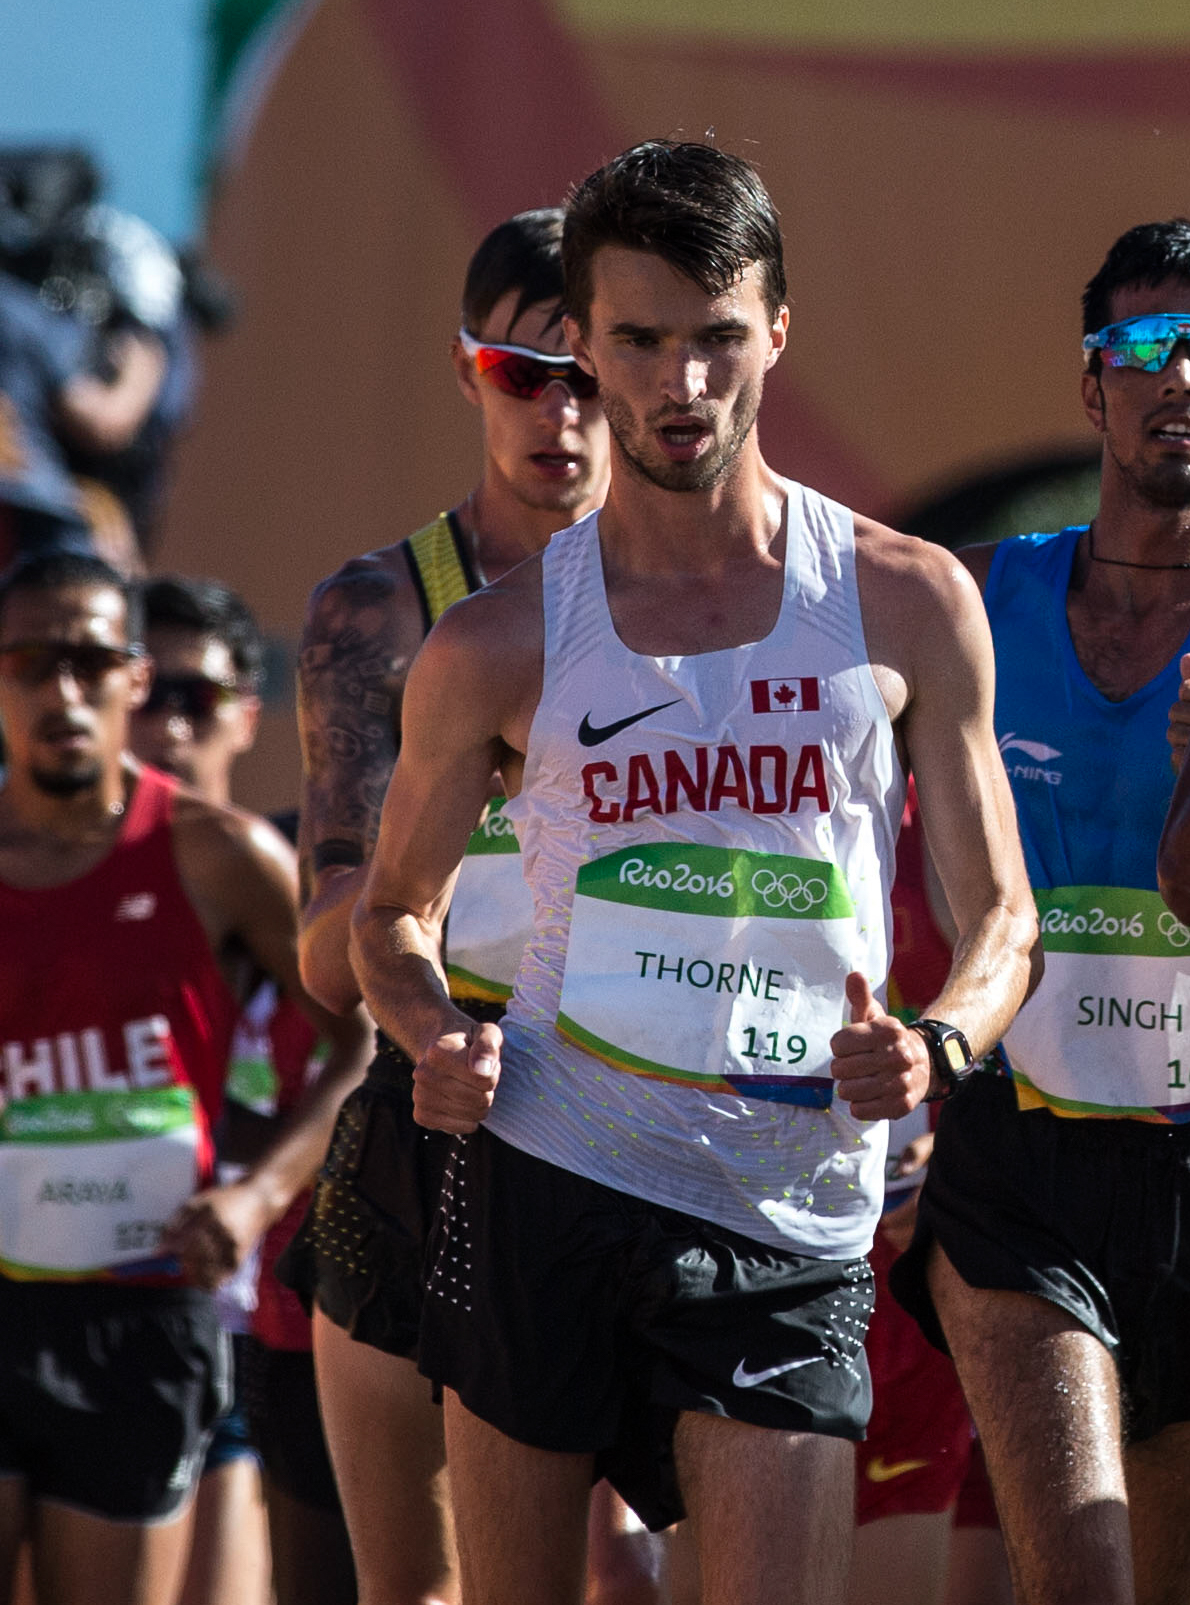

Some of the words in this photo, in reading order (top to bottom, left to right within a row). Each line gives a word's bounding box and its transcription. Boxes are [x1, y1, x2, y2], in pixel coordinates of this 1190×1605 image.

[581, 745, 831, 824] CANADA
[619, 858, 734, 899] Rio2016
[1041, 907, 1144, 938] Rio2016
[635, 950, 784, 1001] THORNE
[1078, 995, 1183, 1032] SINGH
[0, 1015, 172, 1101] HILE
[741, 1026, 807, 1064] 119
